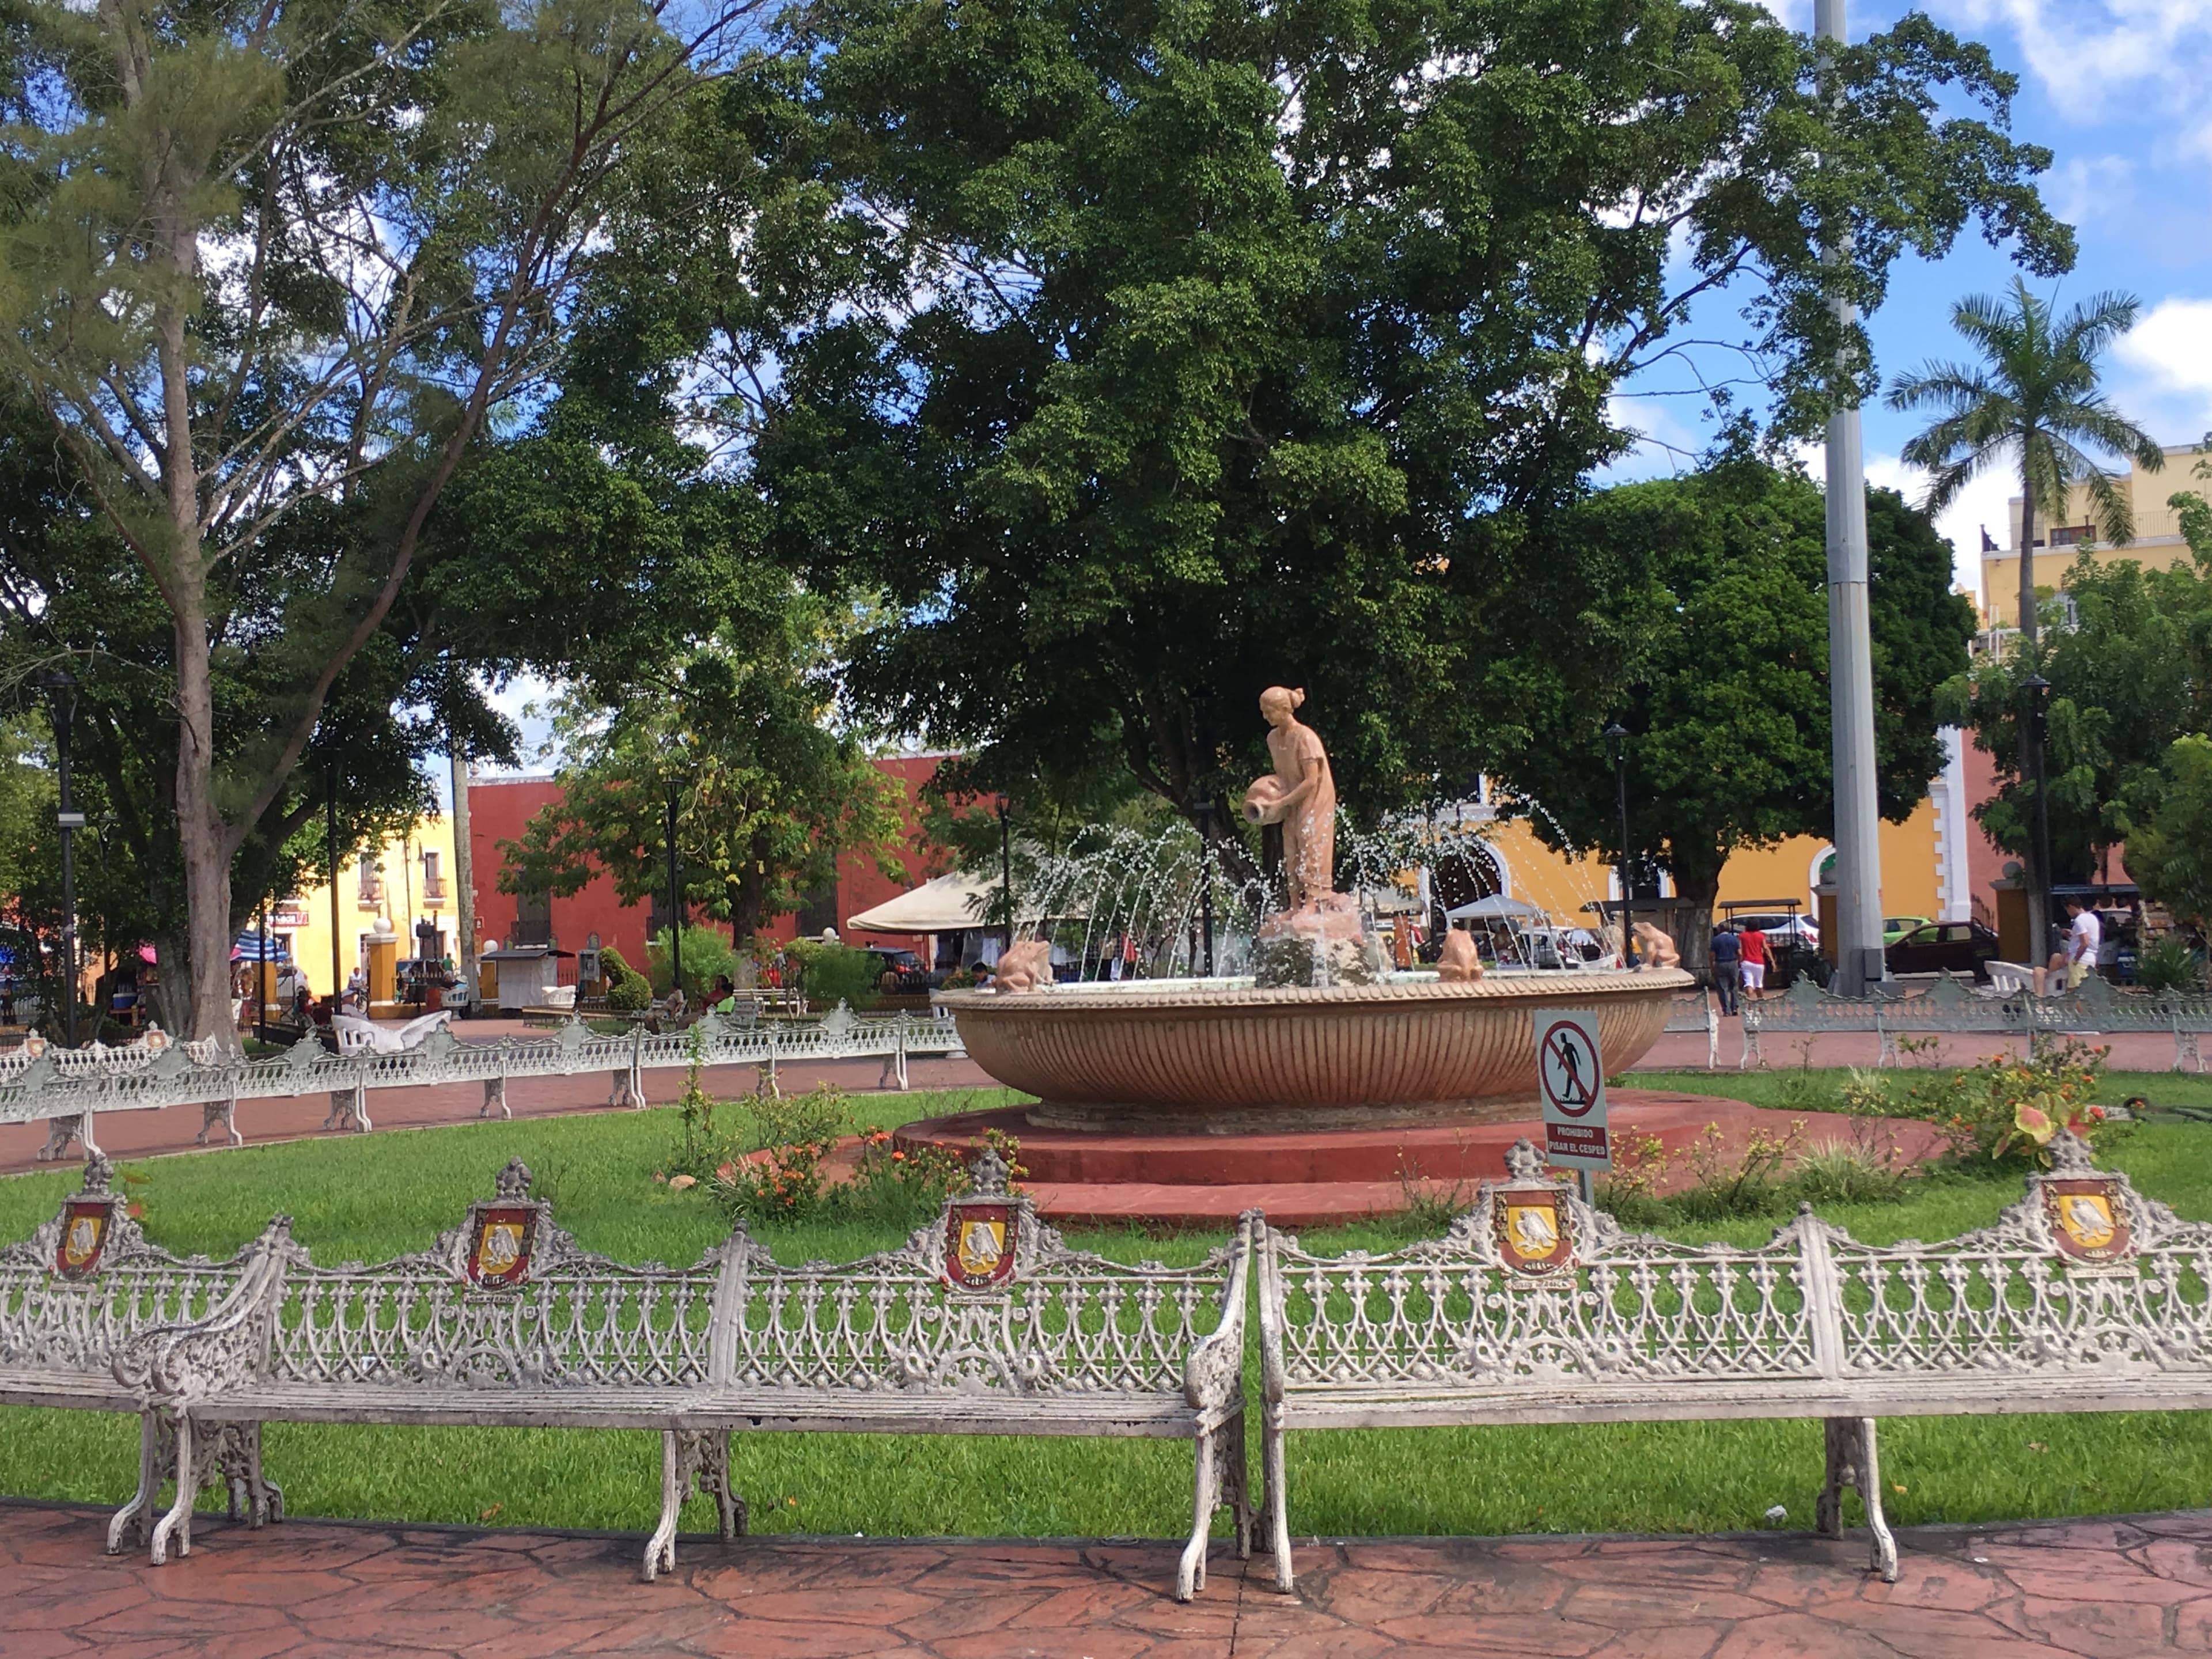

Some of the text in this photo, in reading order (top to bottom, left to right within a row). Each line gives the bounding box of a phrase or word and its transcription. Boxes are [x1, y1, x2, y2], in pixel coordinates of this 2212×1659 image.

[1557, 1126, 1593, 1138] PROHIBIDO
[1548, 1141, 1605, 1155] PISAR EL CESPED
